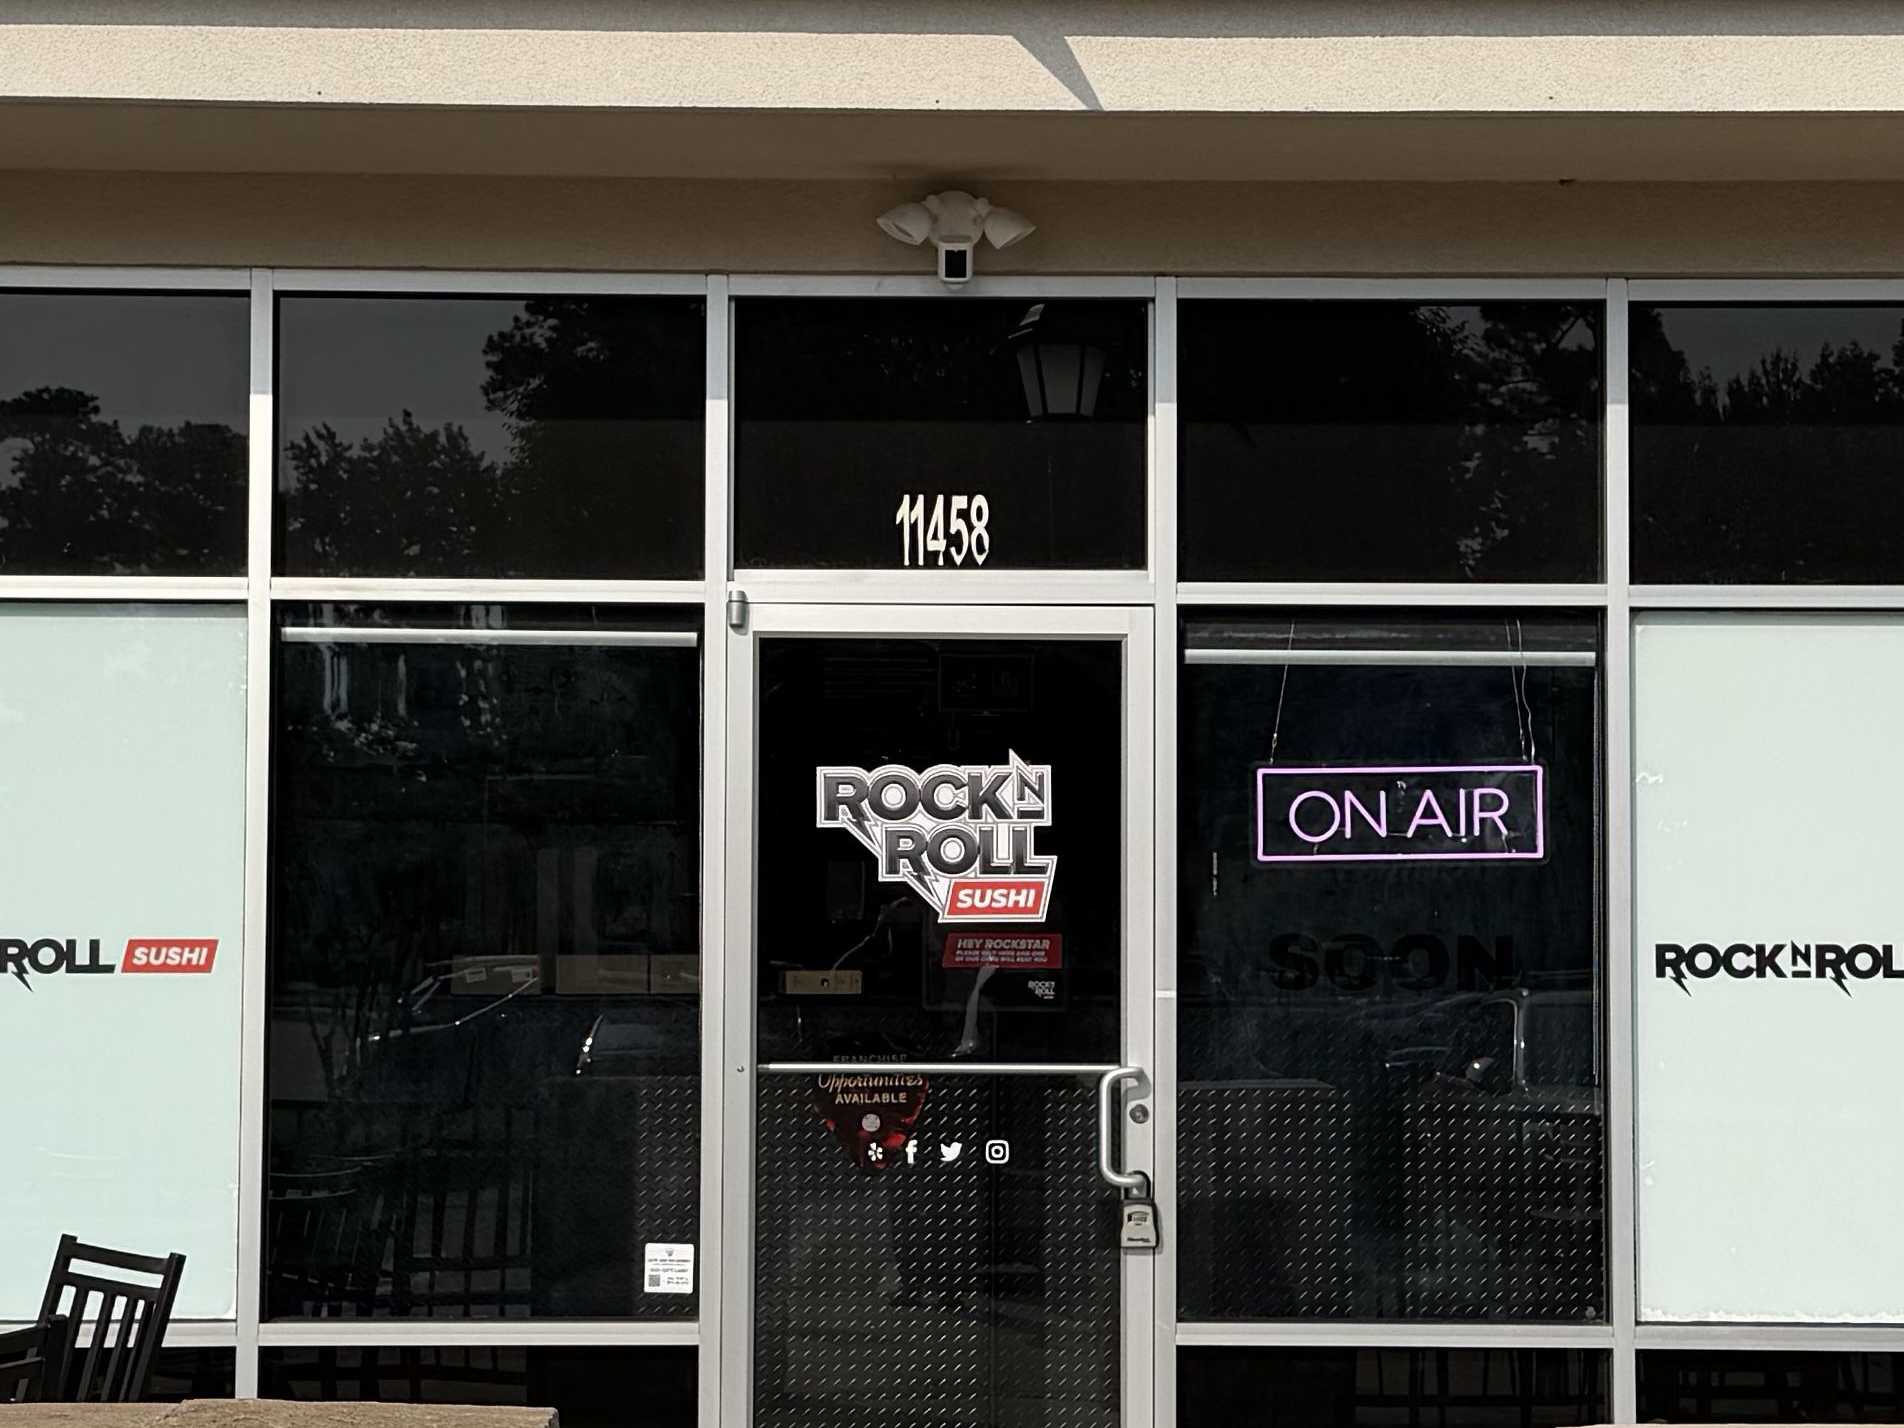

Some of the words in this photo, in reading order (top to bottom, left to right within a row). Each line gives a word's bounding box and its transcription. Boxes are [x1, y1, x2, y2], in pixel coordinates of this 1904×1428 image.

[895, 493, 990, 567] 11458
[821, 771, 1014, 848] ROCK
[1288, 789, 1388, 843] ON
[1406, 787, 1510, 839] AIR
[884, 824, 1051, 906] ROLL
[955, 888, 1036, 909] SUSHI
[131, 945, 208, 967] SUSHI
[984, 938, 1051, 951] ROCKSTAR
[1267, 932, 1514, 992] SOON
[834, 1091, 908, 1105] AVAILABLE
